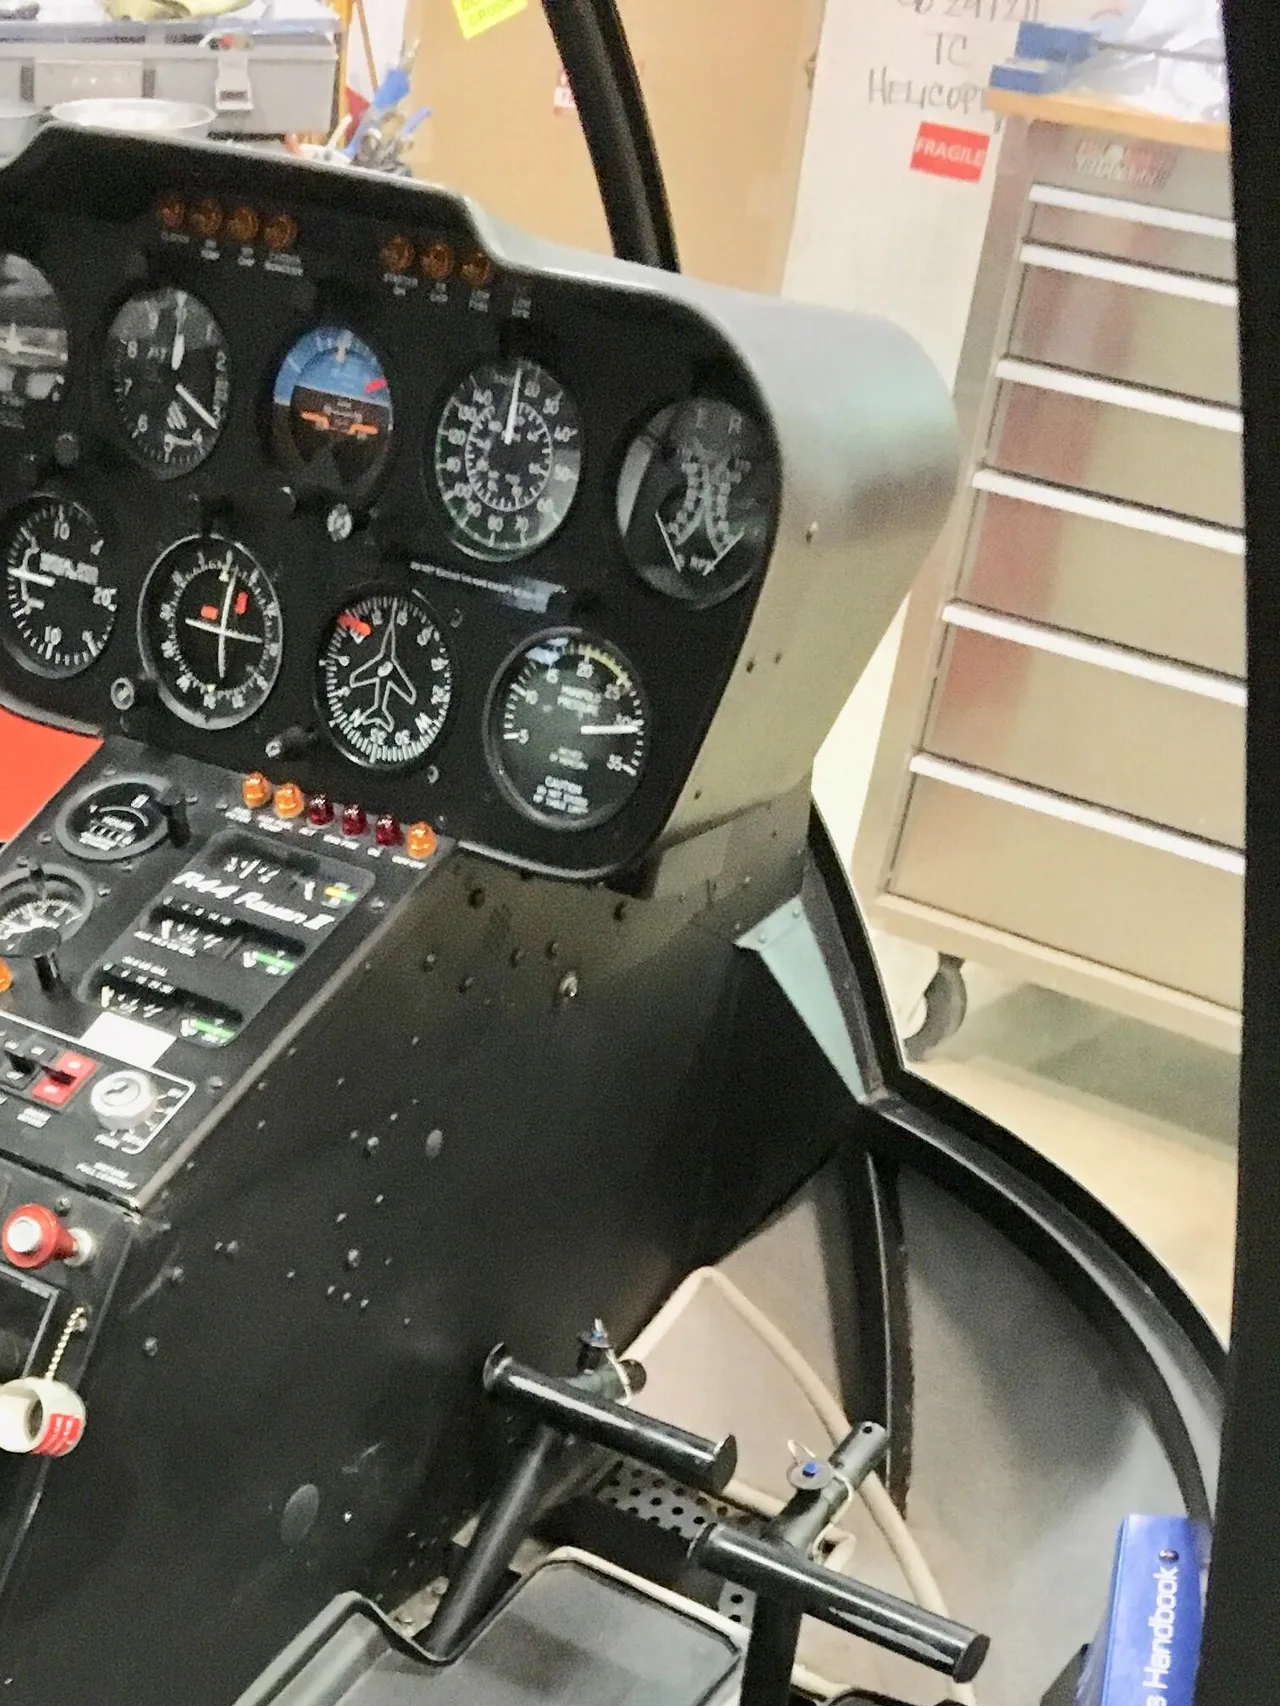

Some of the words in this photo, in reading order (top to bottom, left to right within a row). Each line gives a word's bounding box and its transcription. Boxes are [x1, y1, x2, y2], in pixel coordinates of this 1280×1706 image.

[915, 136, 986, 169] FRAGILE
[172, 870, 242, 900] R44
[1143, 1566, 1179, 1688] Handbook
